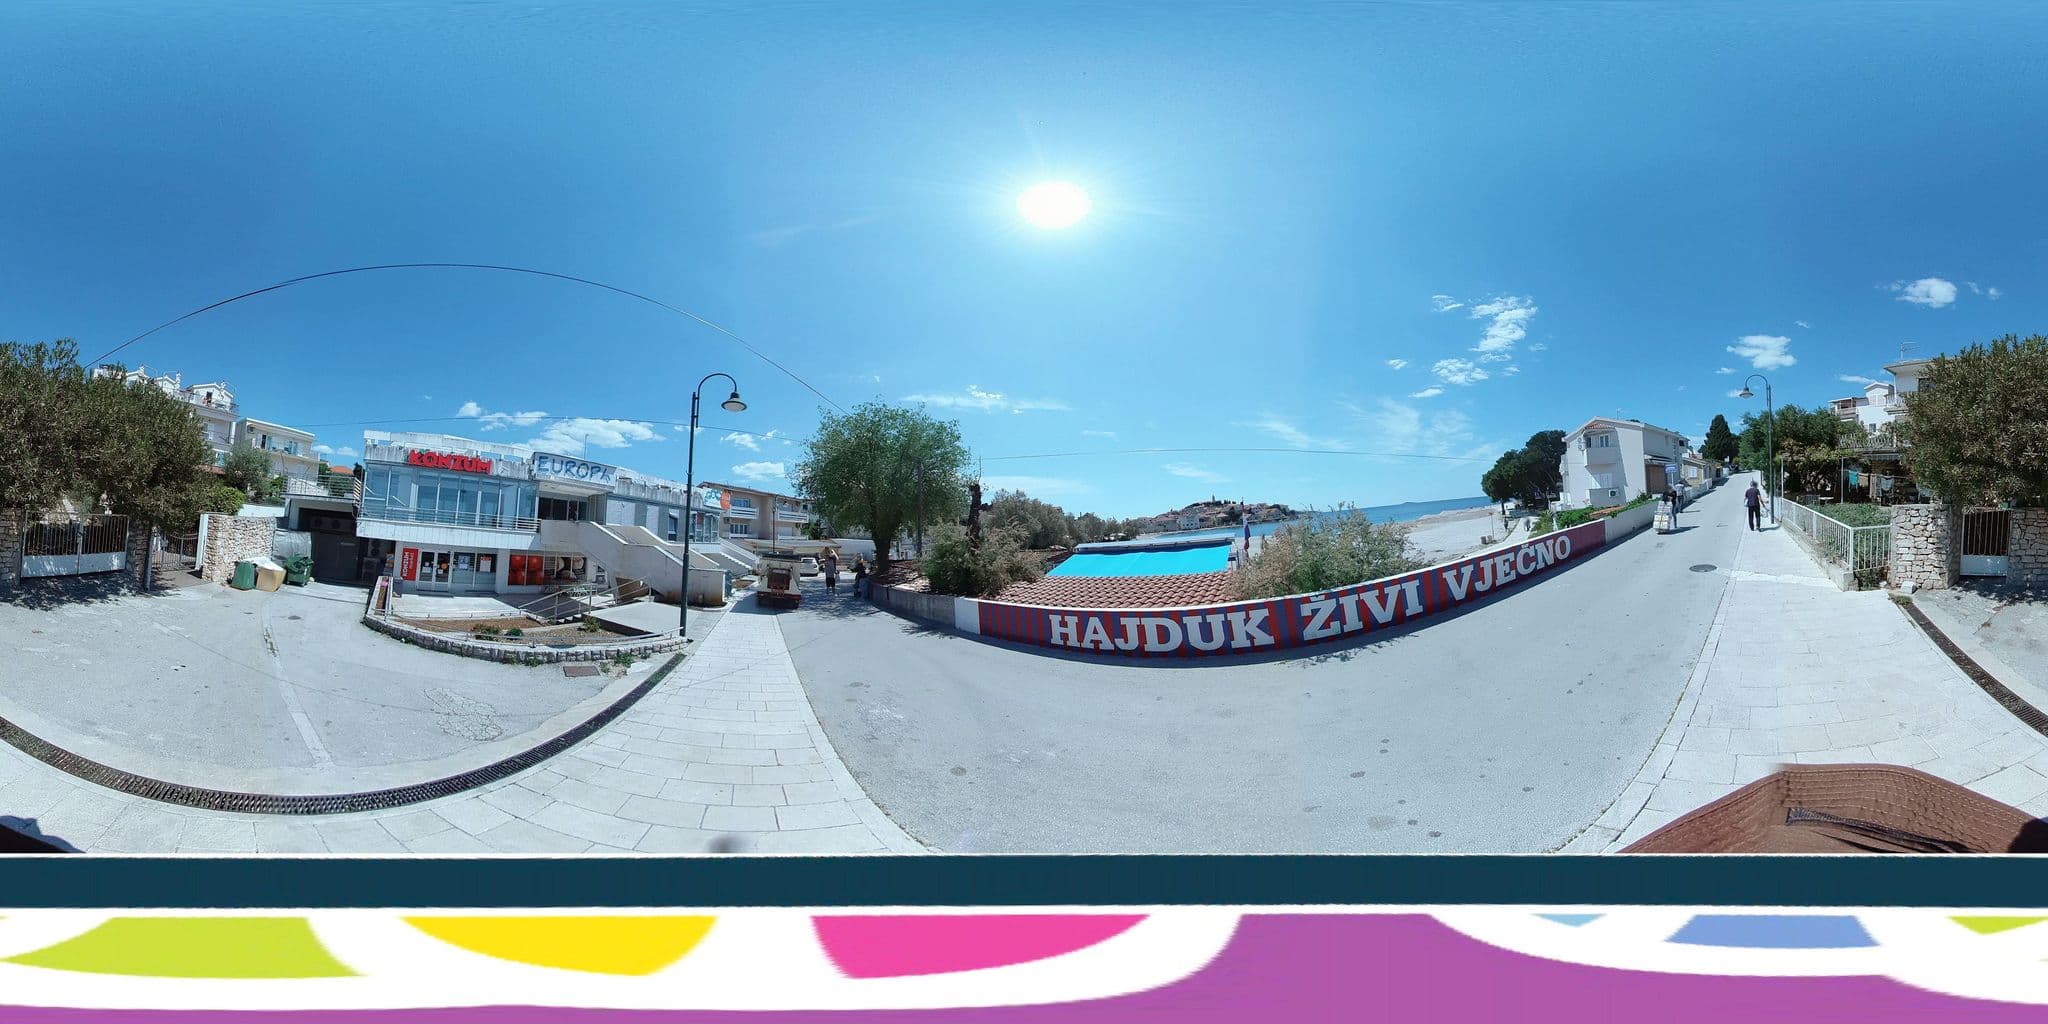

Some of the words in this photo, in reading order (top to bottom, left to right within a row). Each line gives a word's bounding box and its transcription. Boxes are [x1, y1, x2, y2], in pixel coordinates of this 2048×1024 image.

[409, 449, 492, 474] KONZUM
[538, 455, 611, 483] EUROPA
[1049, 608, 1275, 652] HAJDUK
[1301, 579, 1424, 641] ŽIVI
[1442, 535, 1572, 601] VJEČNO
